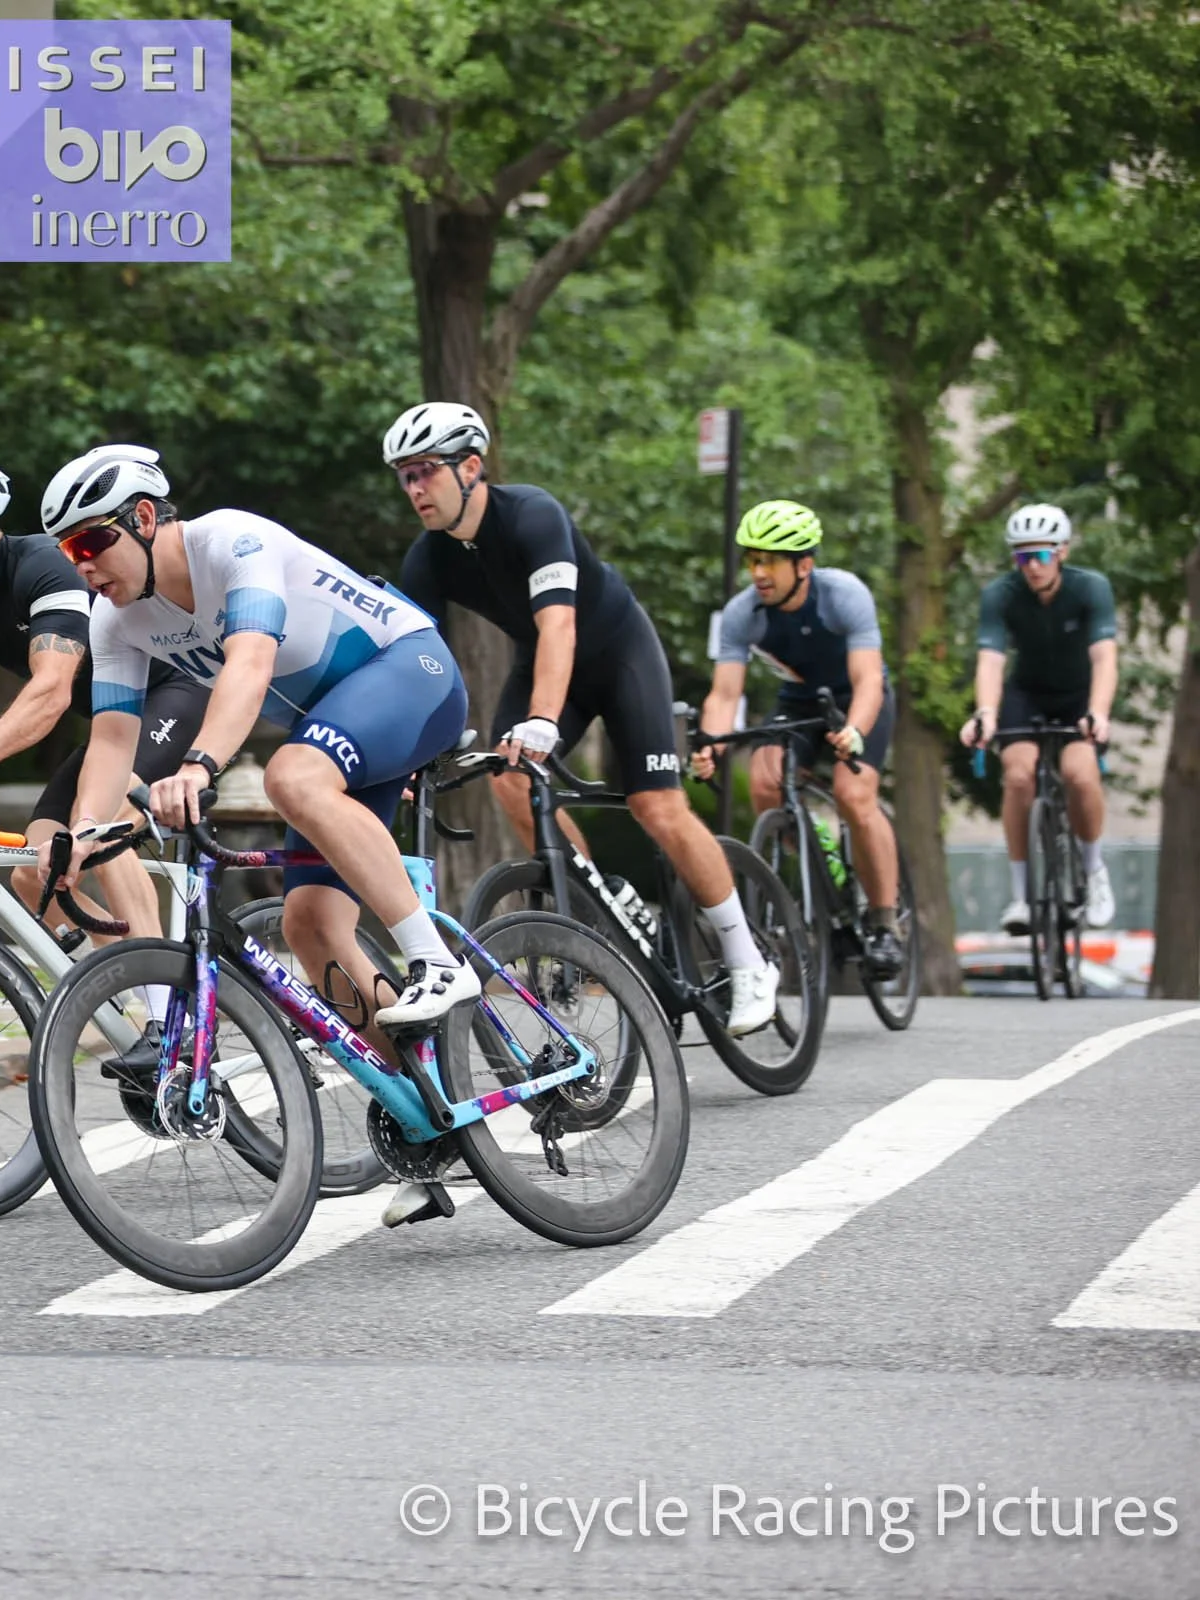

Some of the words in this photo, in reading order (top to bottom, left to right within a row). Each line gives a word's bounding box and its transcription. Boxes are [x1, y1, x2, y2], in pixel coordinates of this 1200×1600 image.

[312, 569, 398, 625] TREK
[303, 724, 360, 773] NYCC
[243, 935, 387, 1070] WINSPACE
